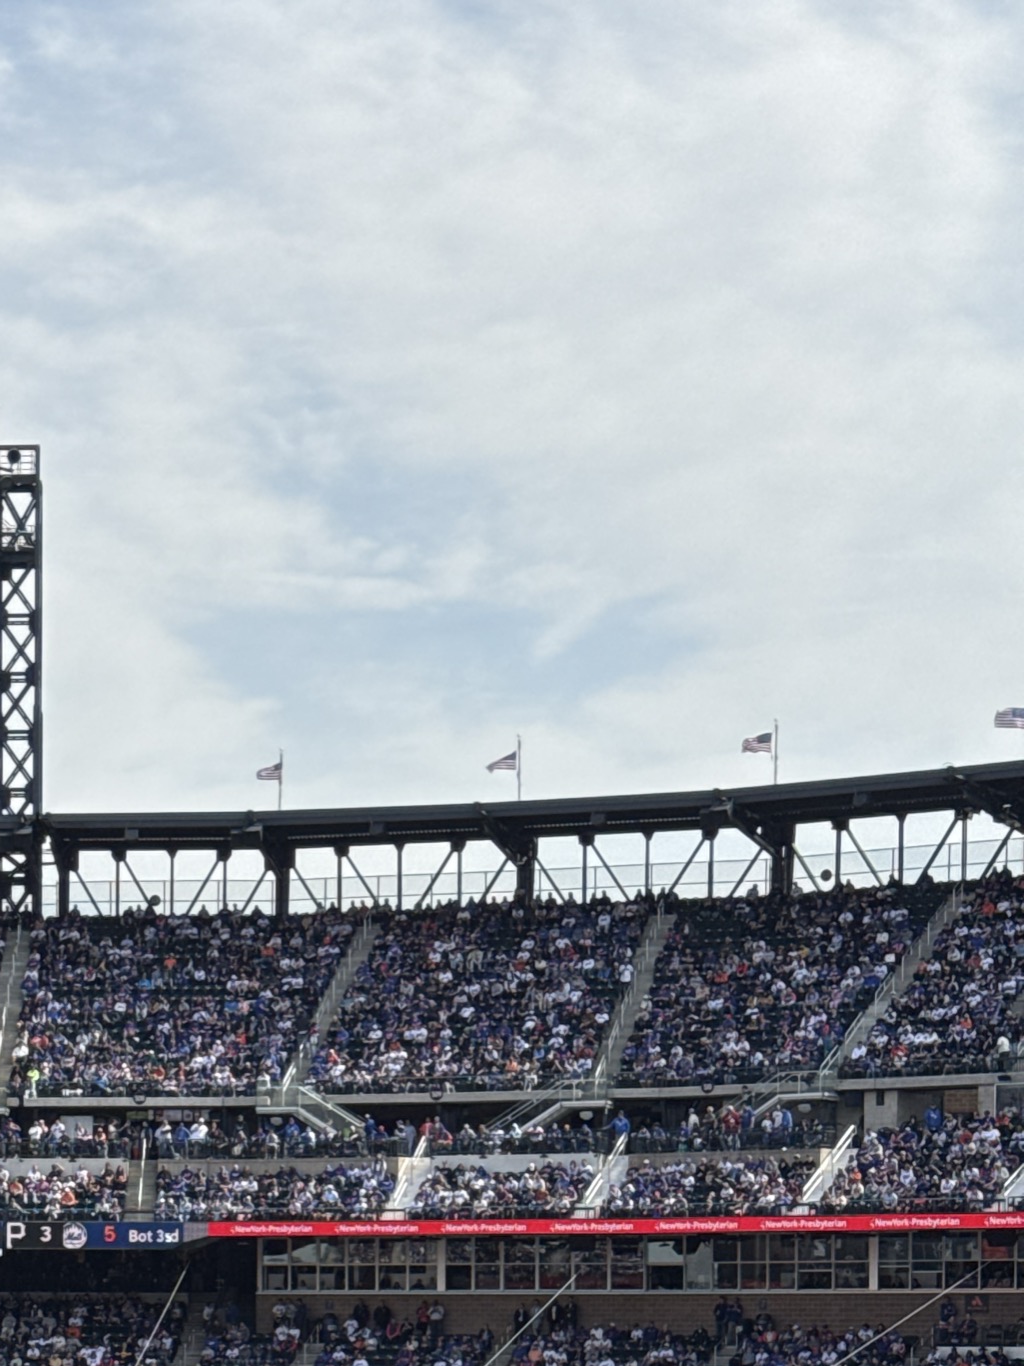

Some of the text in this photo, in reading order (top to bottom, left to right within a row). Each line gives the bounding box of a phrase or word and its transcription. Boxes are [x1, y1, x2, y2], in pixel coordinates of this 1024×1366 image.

[39, 1226, 52, 1242] 3
[105, 1226, 116, 1242] 5
[129, 1229, 153, 1243] Bot
